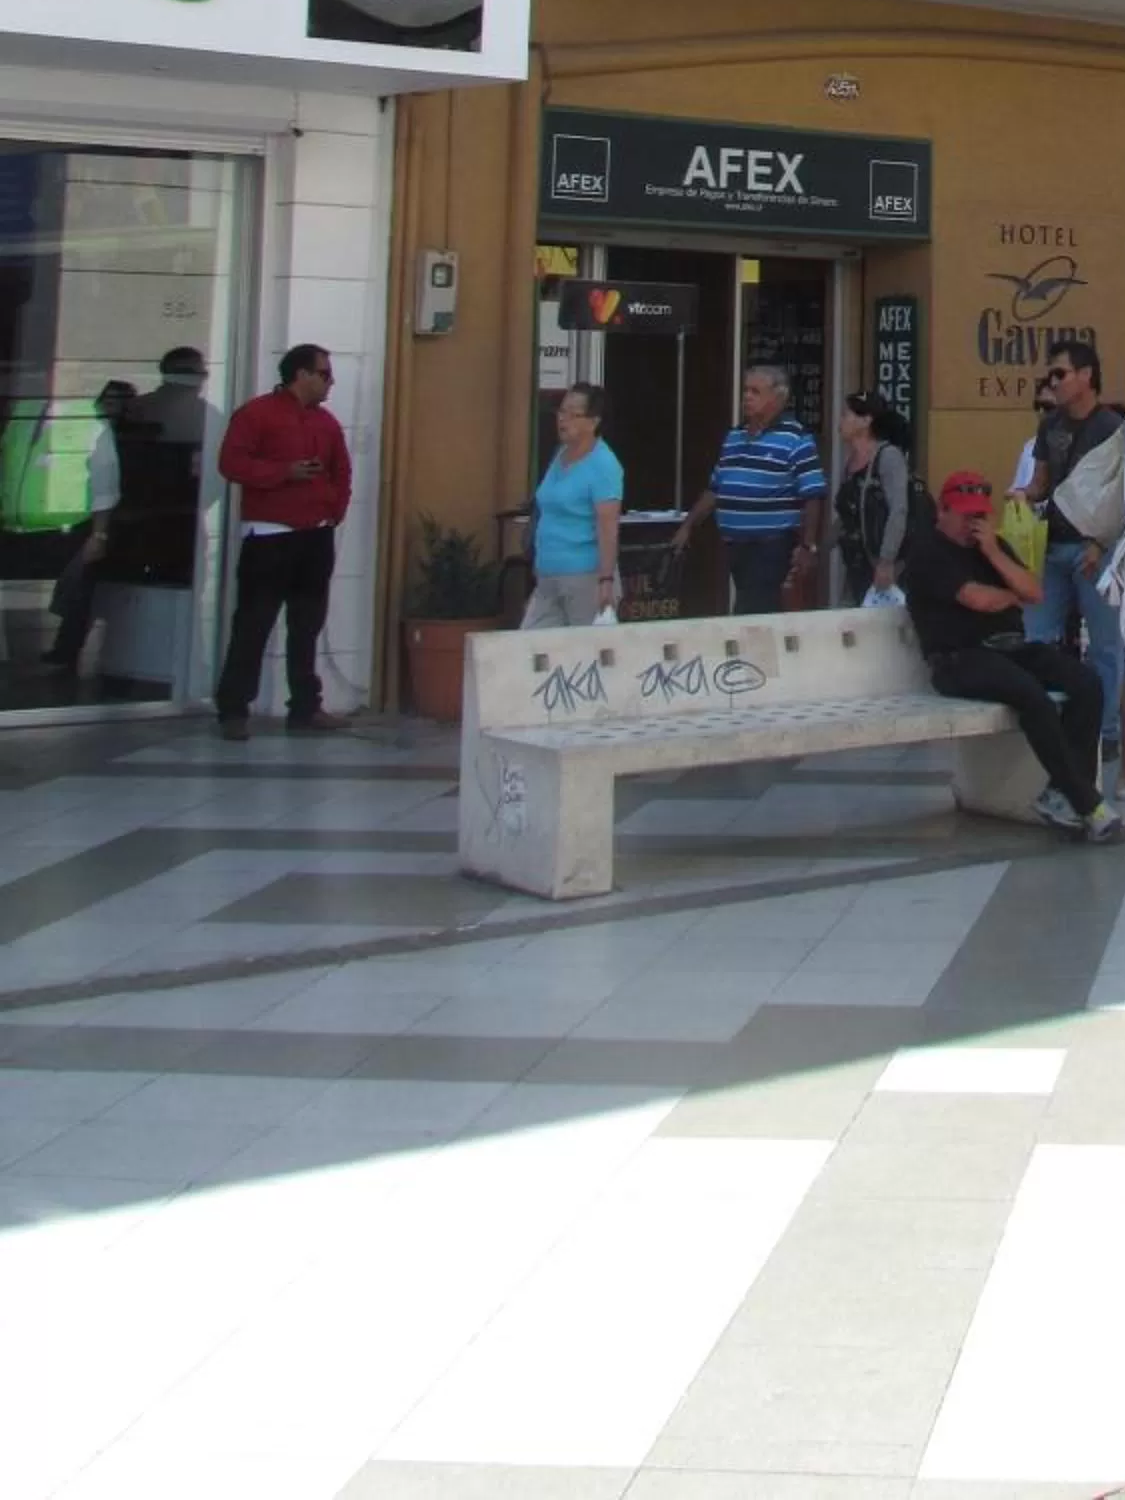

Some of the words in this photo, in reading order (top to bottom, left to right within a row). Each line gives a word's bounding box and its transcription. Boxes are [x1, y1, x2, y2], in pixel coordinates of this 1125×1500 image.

[682, 145, 805, 194] AFEX
[556, 172, 606, 193] AFEX
[874, 195, 913, 213] AFEX
[1000, 224, 1079, 247] HOTEL
[879, 305, 913, 332] AFEX
